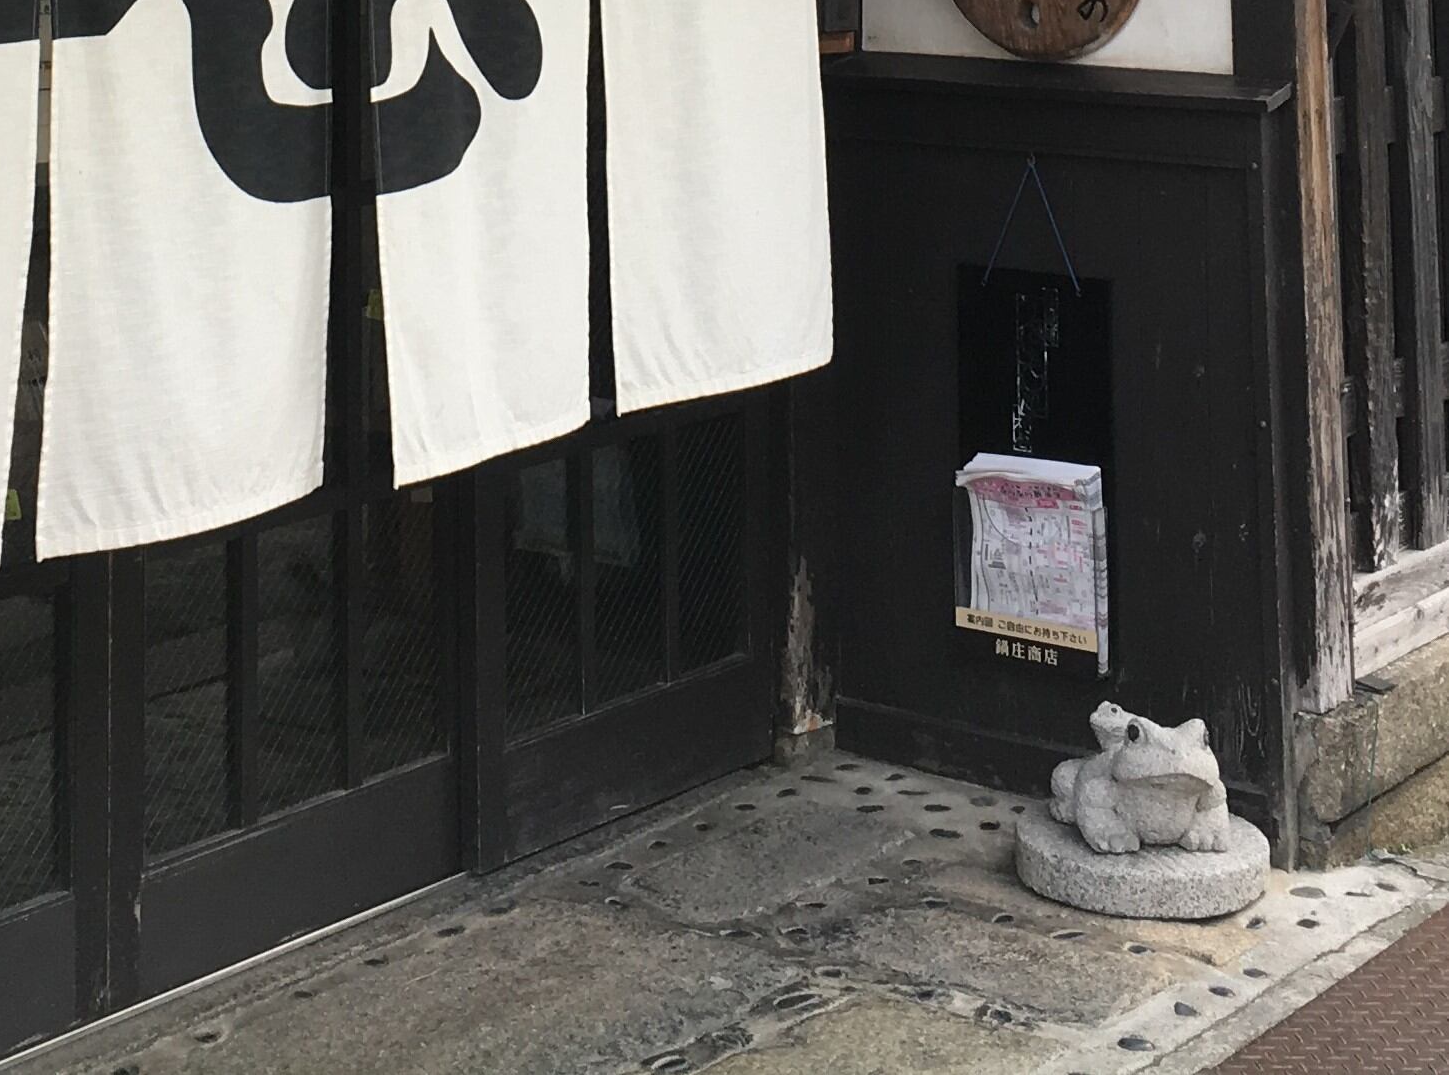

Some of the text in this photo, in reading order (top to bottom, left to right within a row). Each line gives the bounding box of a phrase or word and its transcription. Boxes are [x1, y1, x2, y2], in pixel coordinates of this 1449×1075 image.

[998, 620, 1087, 645] ご自由にお持ち下さい
[996, 638, 1058, 665] 鍋庄商店
